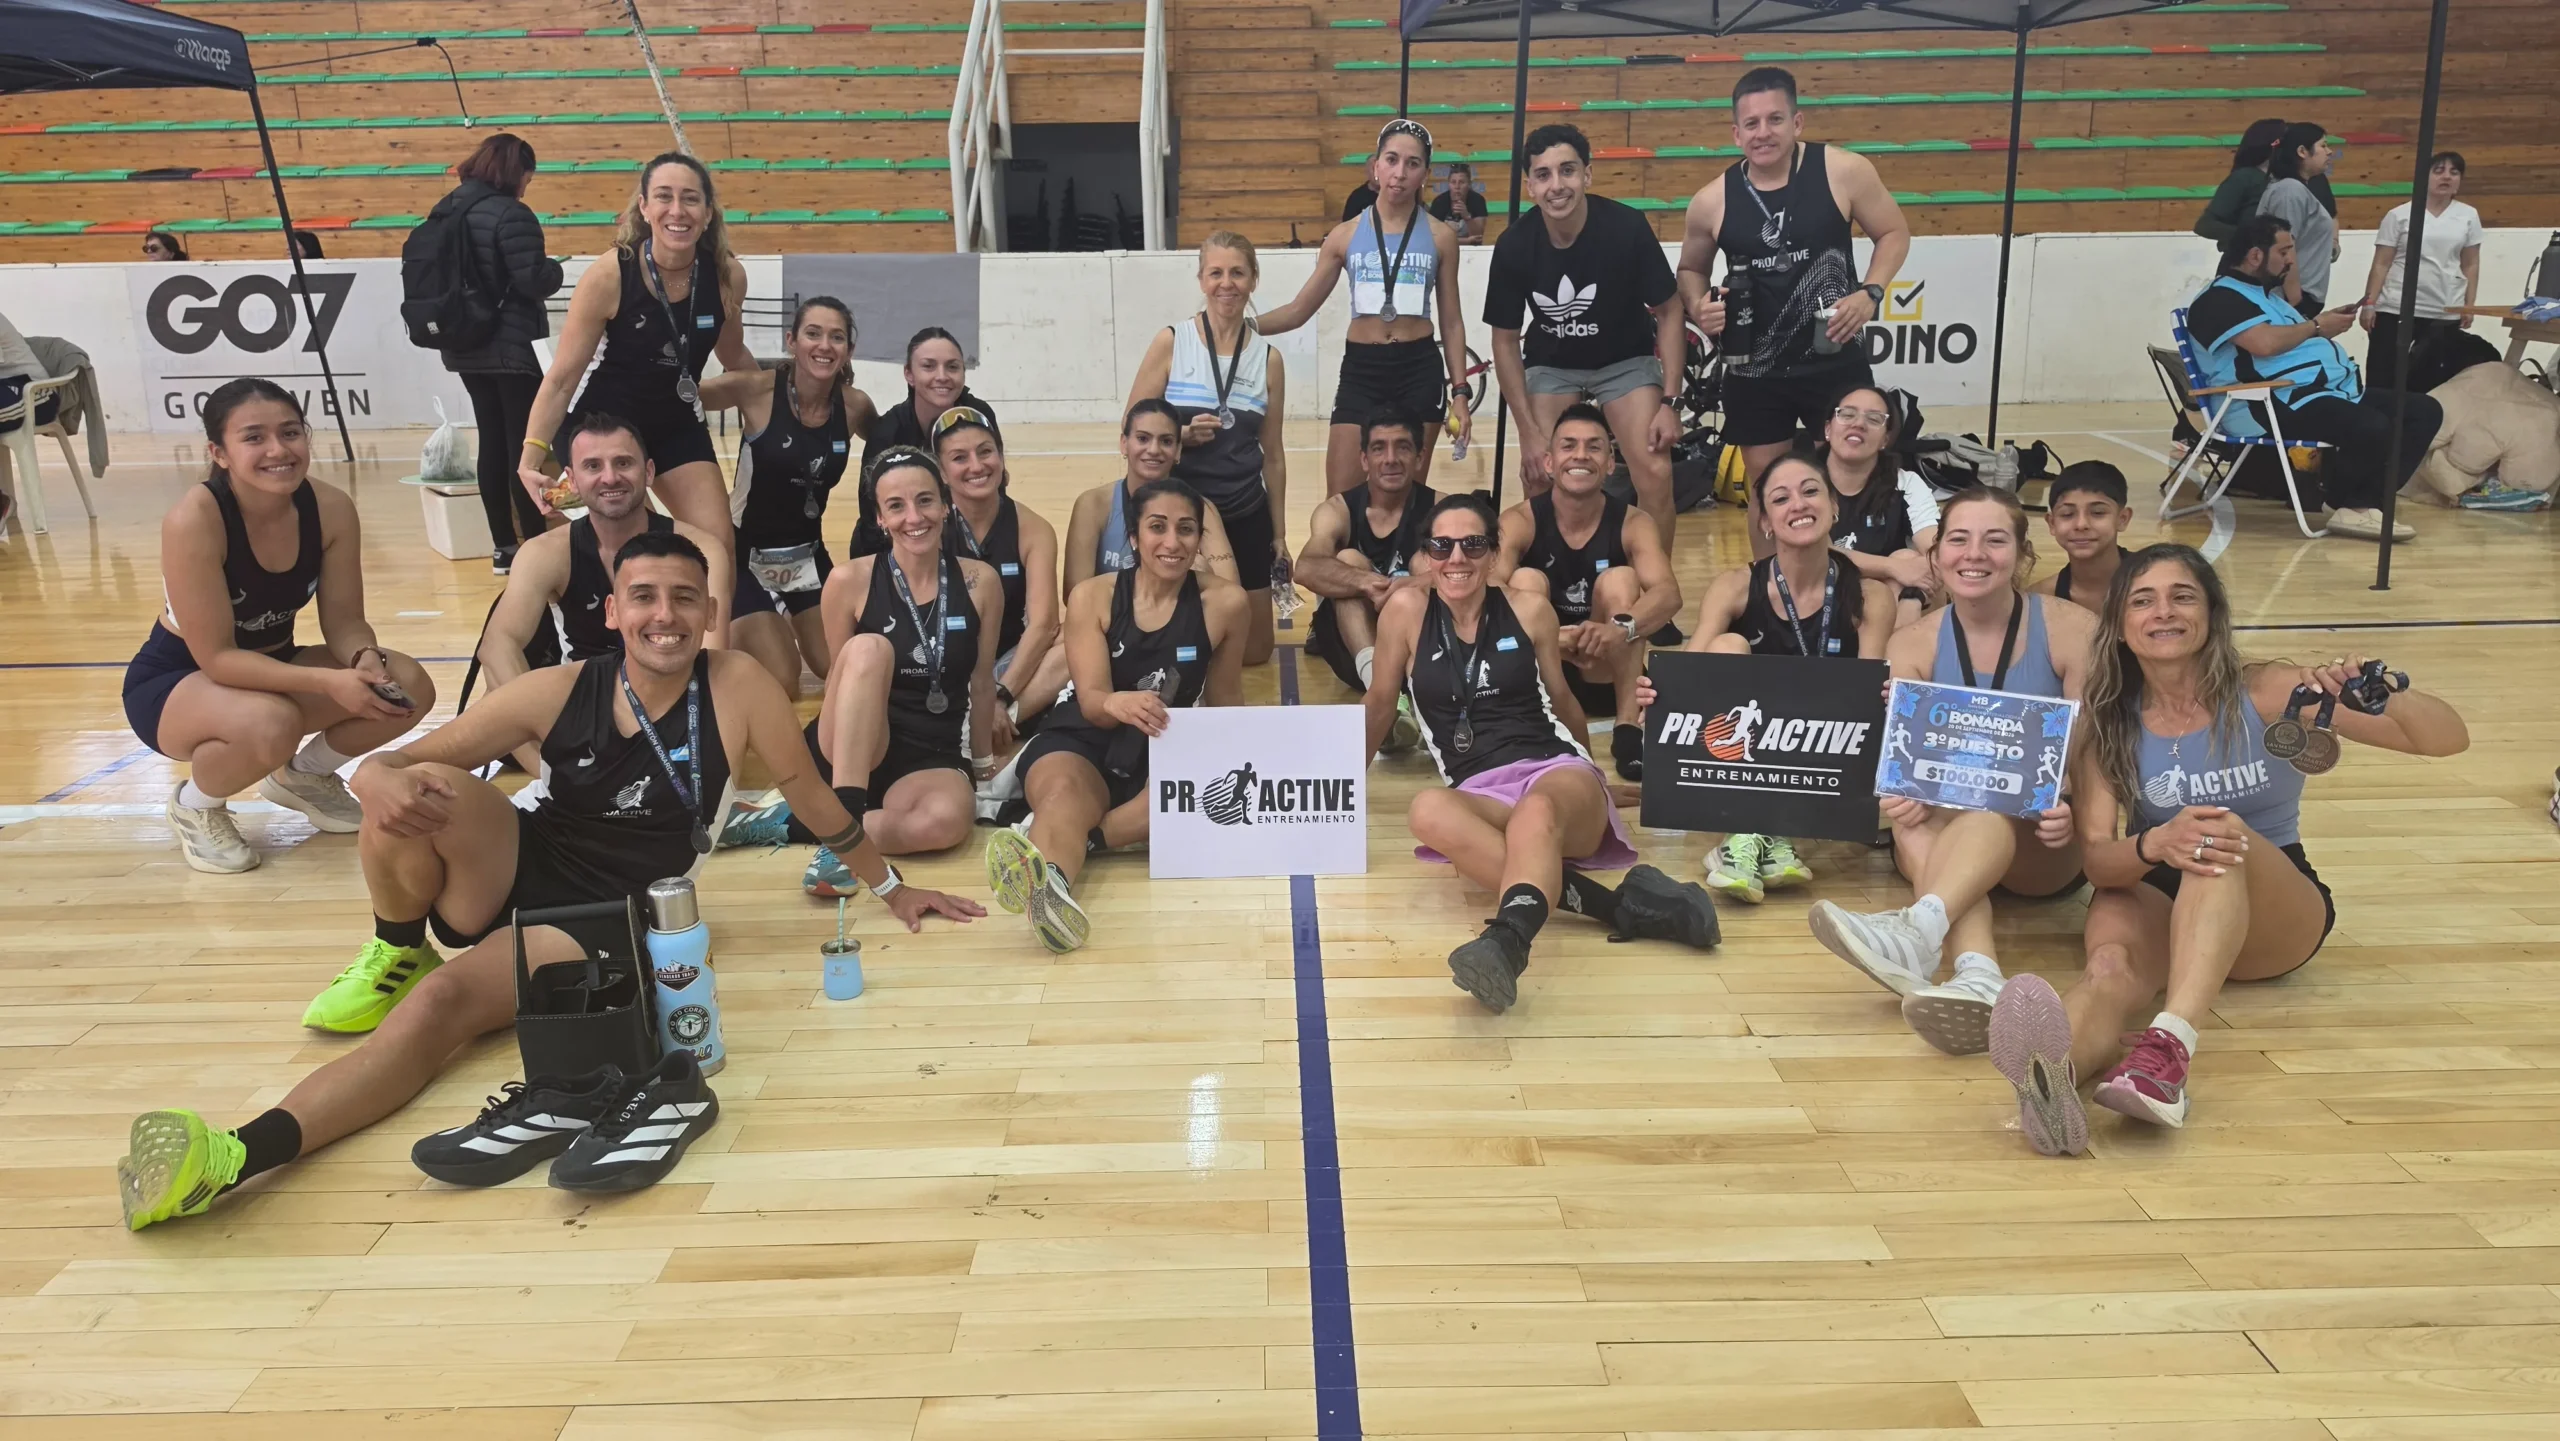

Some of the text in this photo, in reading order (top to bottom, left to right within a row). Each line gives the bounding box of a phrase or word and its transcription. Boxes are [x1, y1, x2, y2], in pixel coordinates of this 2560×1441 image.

[1752, 249, 1810, 269] PROTIVE
[147, 273, 357, 354] GO7
[1540, 319, 1599, 338] adidas
[1971, 695, 1989, 705] MB
[1948, 711, 2025, 734] BONARDA
[638, 714, 659, 746] MARATÓN
[654, 744, 675, 777] BONARDA
[1757, 718, 1871, 755] ACTIVE
[1947, 736, 2025, 761] PUESTO
[1680, 767, 1840, 787] ENTRENAMIENTO
[1926, 766, 2009, 791] $100.000
[2189, 759, 2269, 797] ACTIVE
[1258, 779, 1355, 812] ACTIVE
[2191, 782, 2271, 804] ENTRENAMIENTO
[1257, 814, 1355, 824] ENTRENAMIENTO
